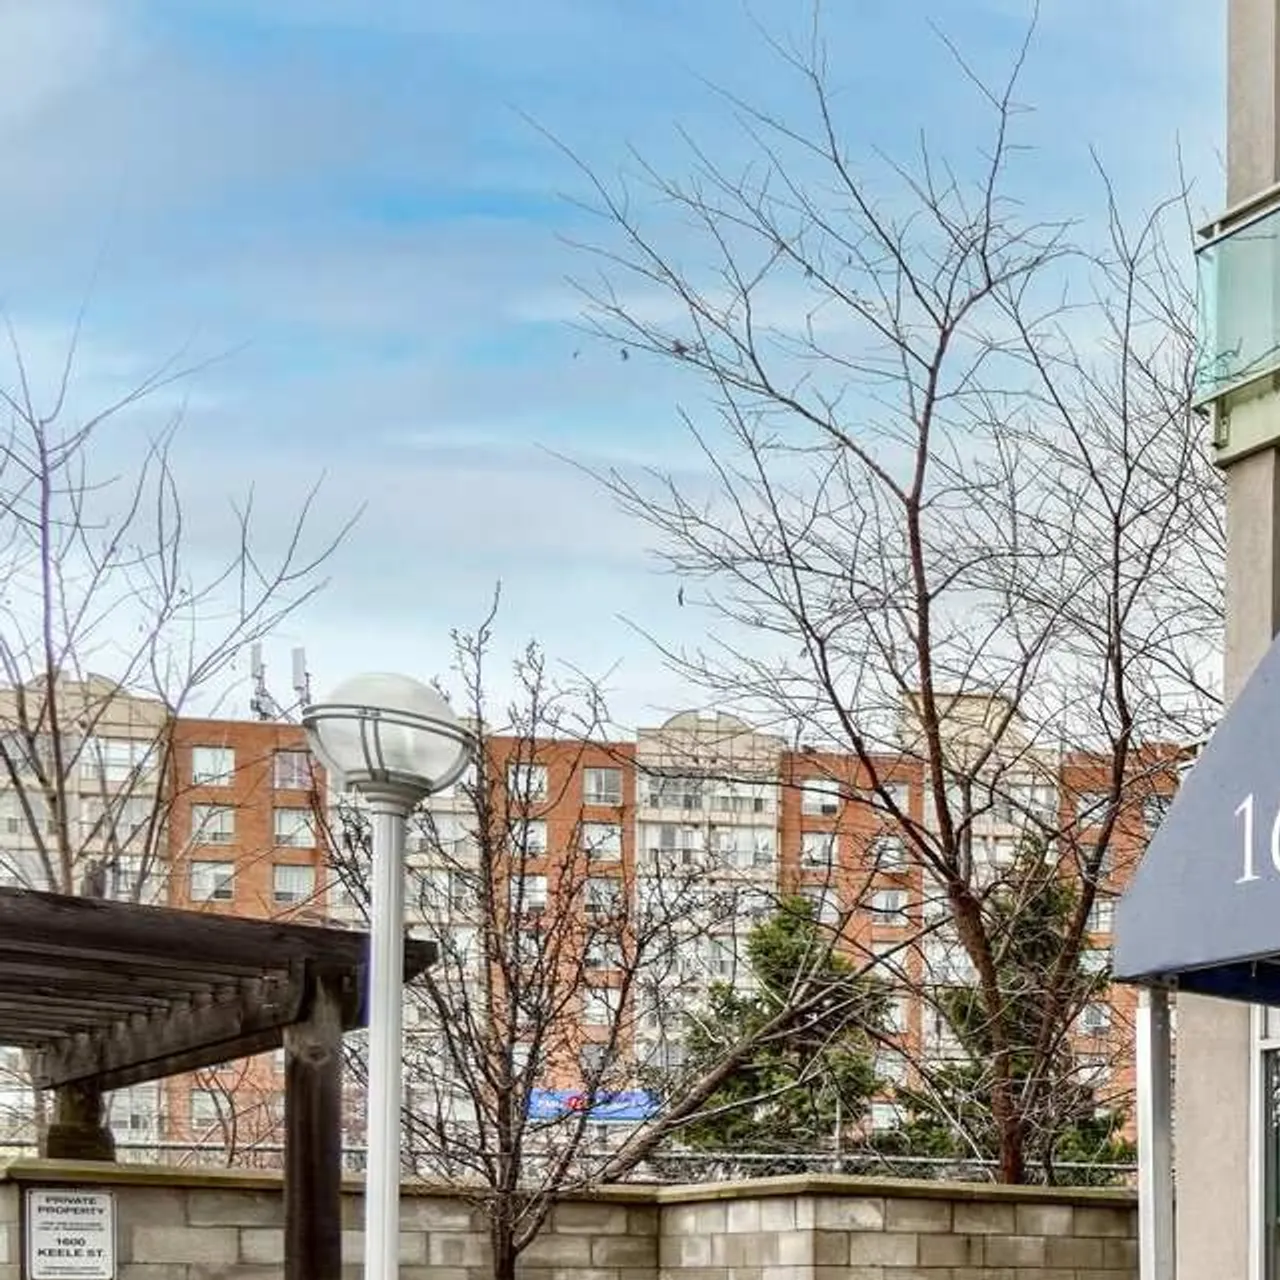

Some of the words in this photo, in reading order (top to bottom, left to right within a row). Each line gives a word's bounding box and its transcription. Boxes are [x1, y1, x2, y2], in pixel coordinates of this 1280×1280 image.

[45, 1196, 97, 1205] PRIVATE
[37, 1206, 104, 1215] PROPERTY
[56, 1237, 86, 1247] 1600
[37, 1248, 84, 1257] KEELE
